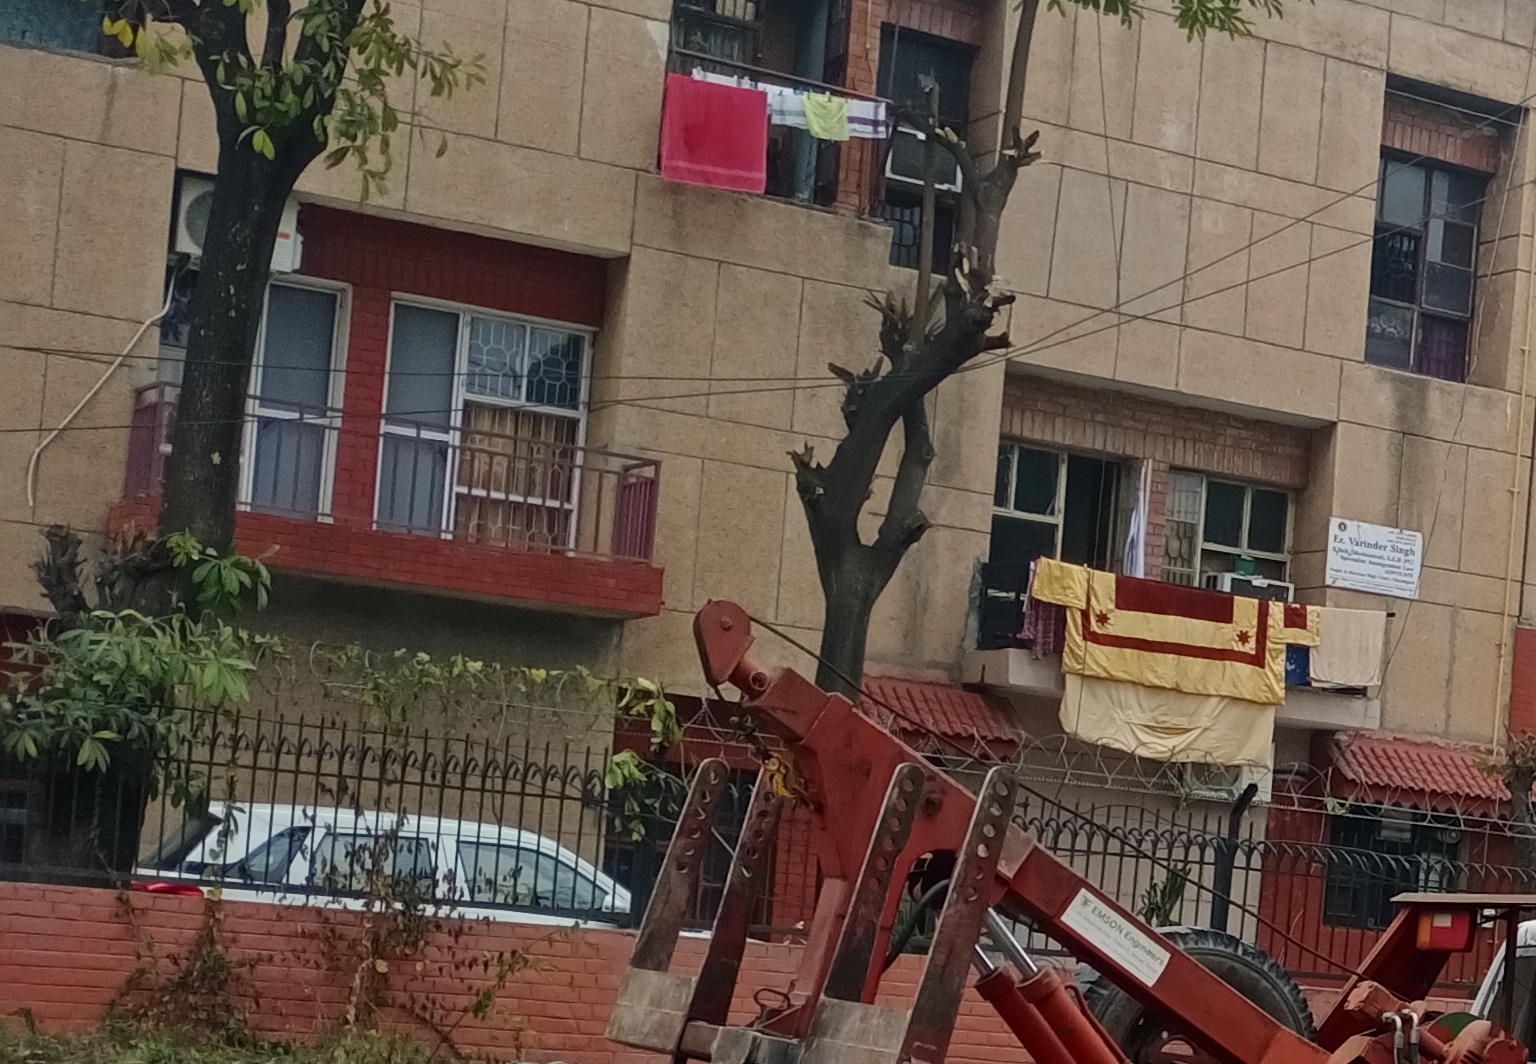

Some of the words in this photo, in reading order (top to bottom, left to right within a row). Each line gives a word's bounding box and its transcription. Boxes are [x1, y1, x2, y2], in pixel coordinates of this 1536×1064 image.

[1348, 537, 1388, 552] Varinder
[1389, 544, 1416, 557] Singh
[1091, 906, 1126, 935] EMSON
